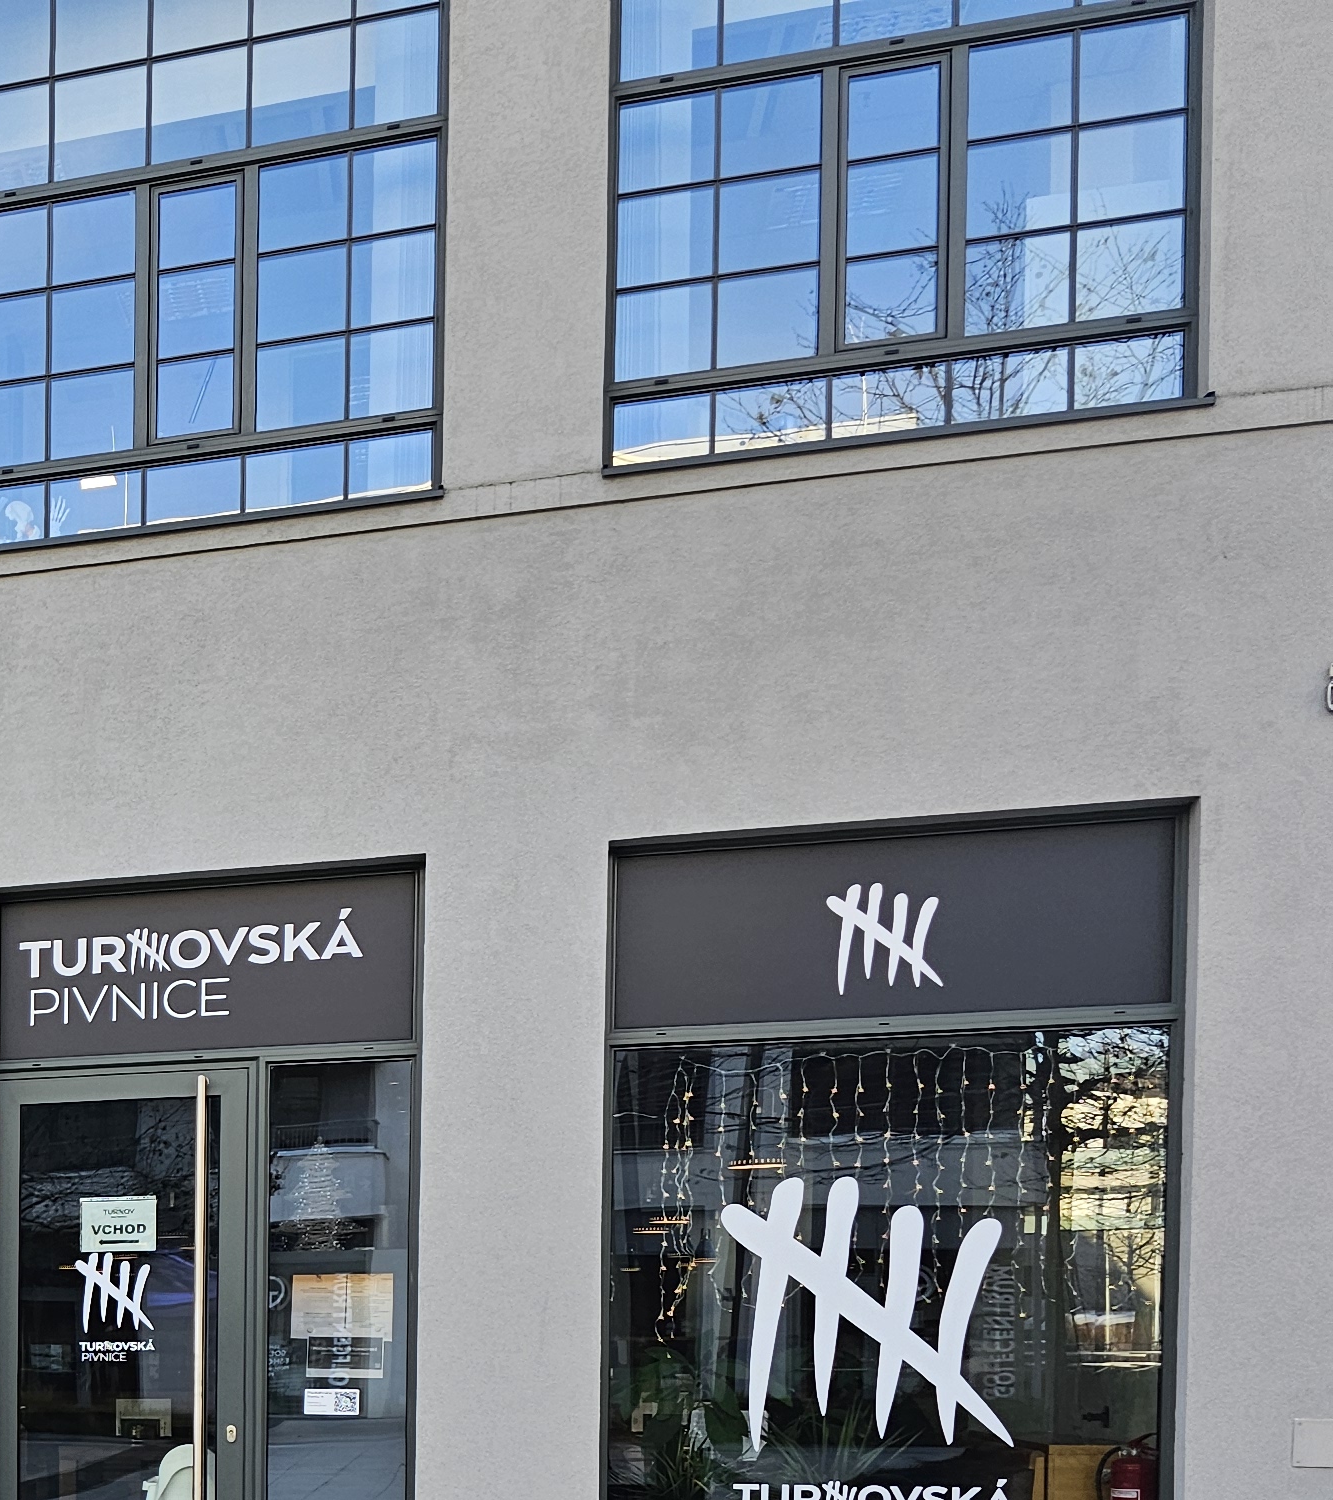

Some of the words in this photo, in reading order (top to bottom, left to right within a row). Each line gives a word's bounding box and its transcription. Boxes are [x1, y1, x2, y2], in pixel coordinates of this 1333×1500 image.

[29, 977, 230, 1026] PIVNICE
[91, 1223, 147, 1235] VCHOD
[82, 1352, 127, 1361] PIVNICE
